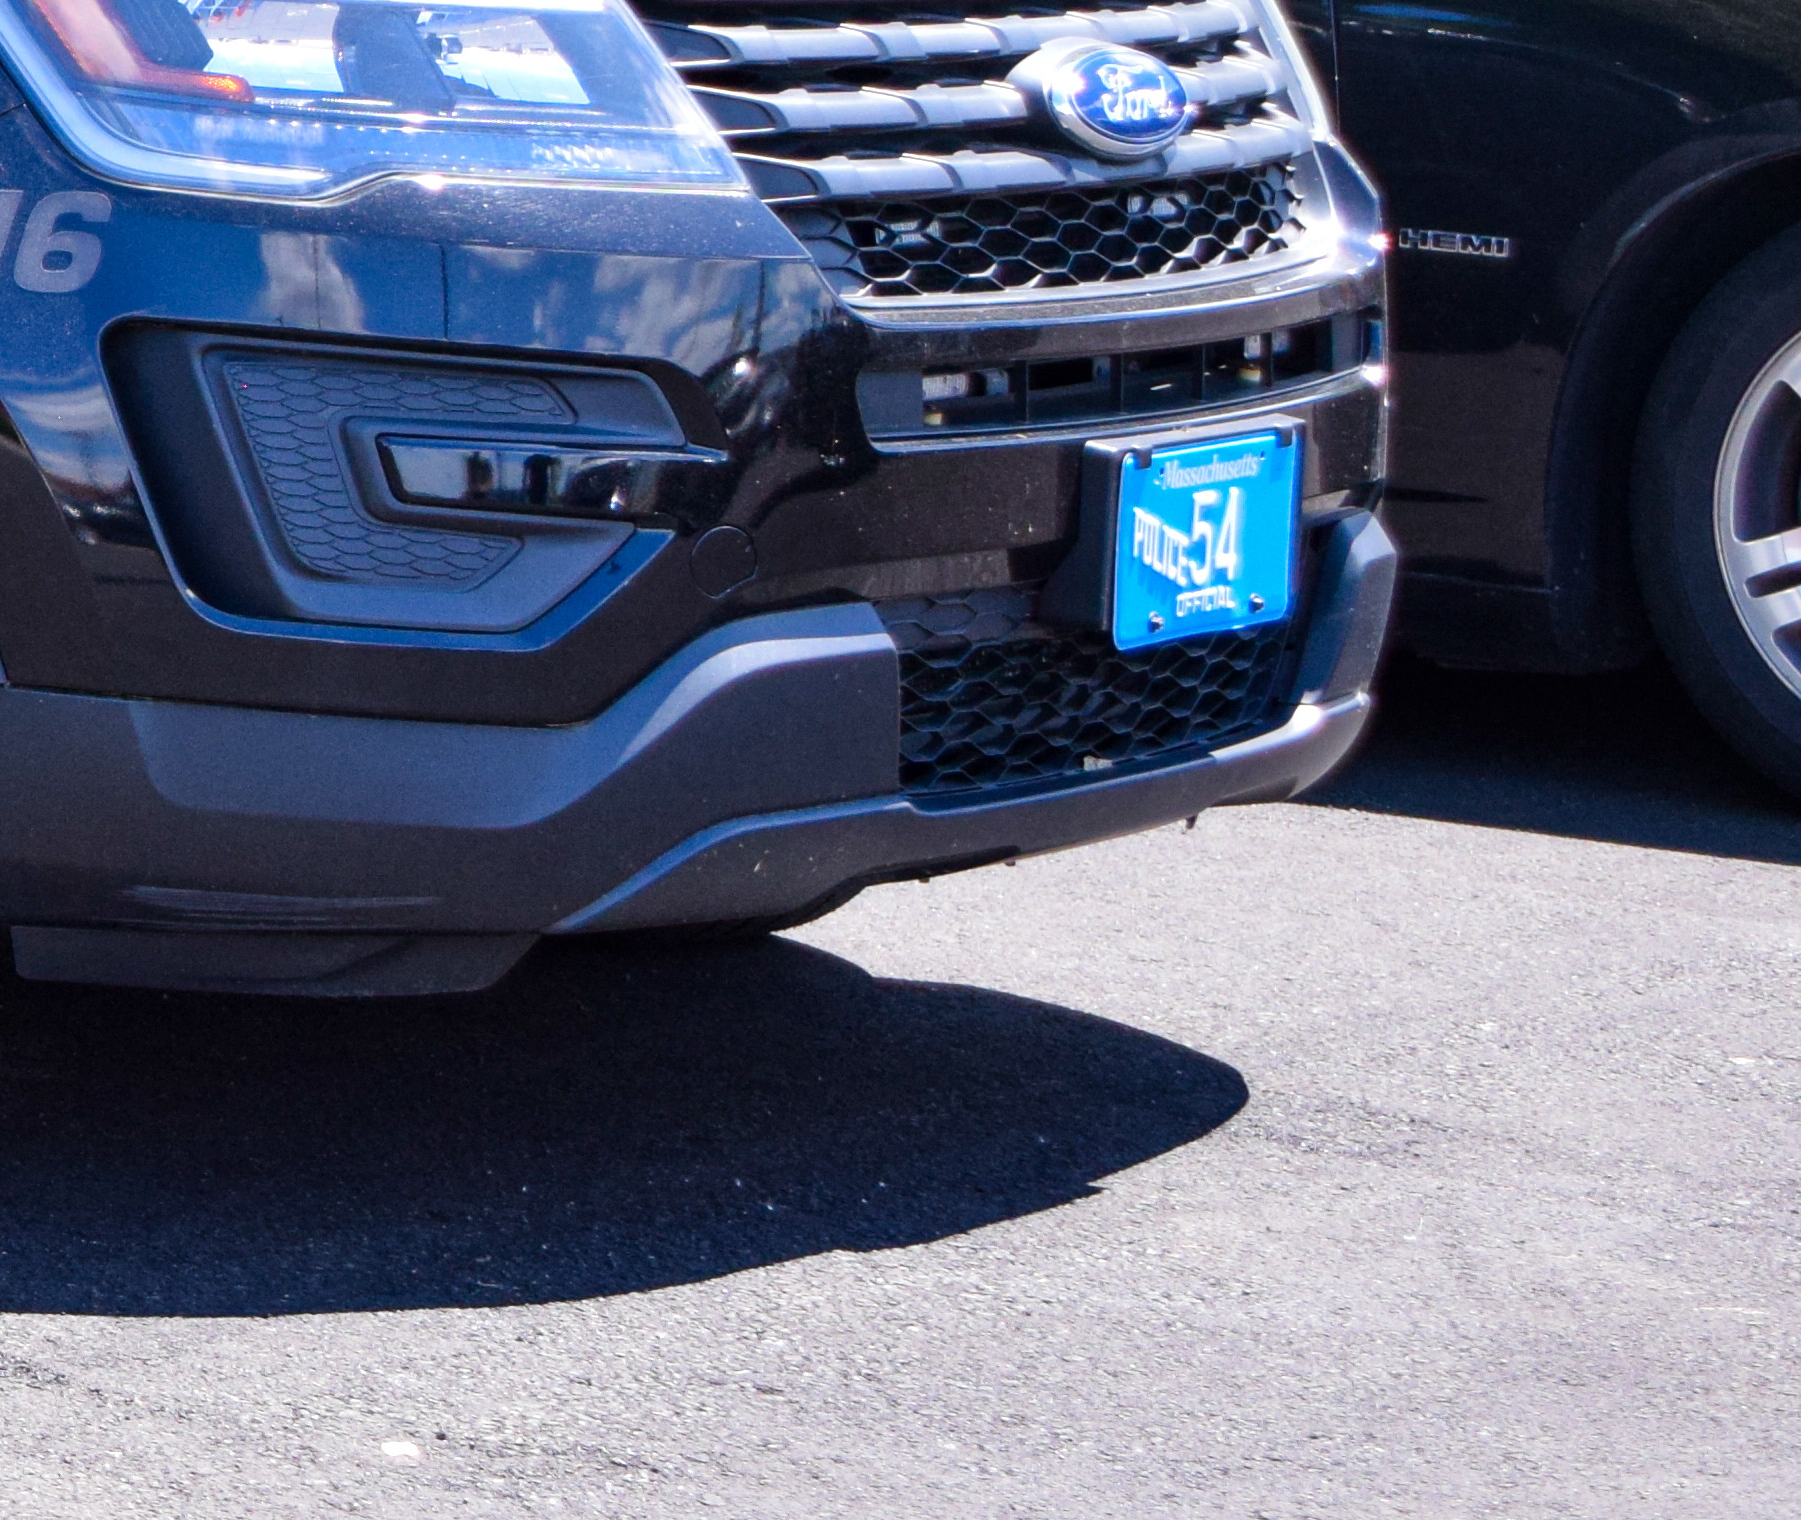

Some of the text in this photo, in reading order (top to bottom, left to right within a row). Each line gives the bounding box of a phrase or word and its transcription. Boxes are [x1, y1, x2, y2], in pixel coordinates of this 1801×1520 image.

[1097, 64, 1173, 121] Ford
[1398, 228, 1510, 258] HEMI
[1163, 453, 1259, 490] Massachusetts
[1132, 486, 1242, 588] POLICE 54
[1176, 585, 1235, 618] OFFICIAL
